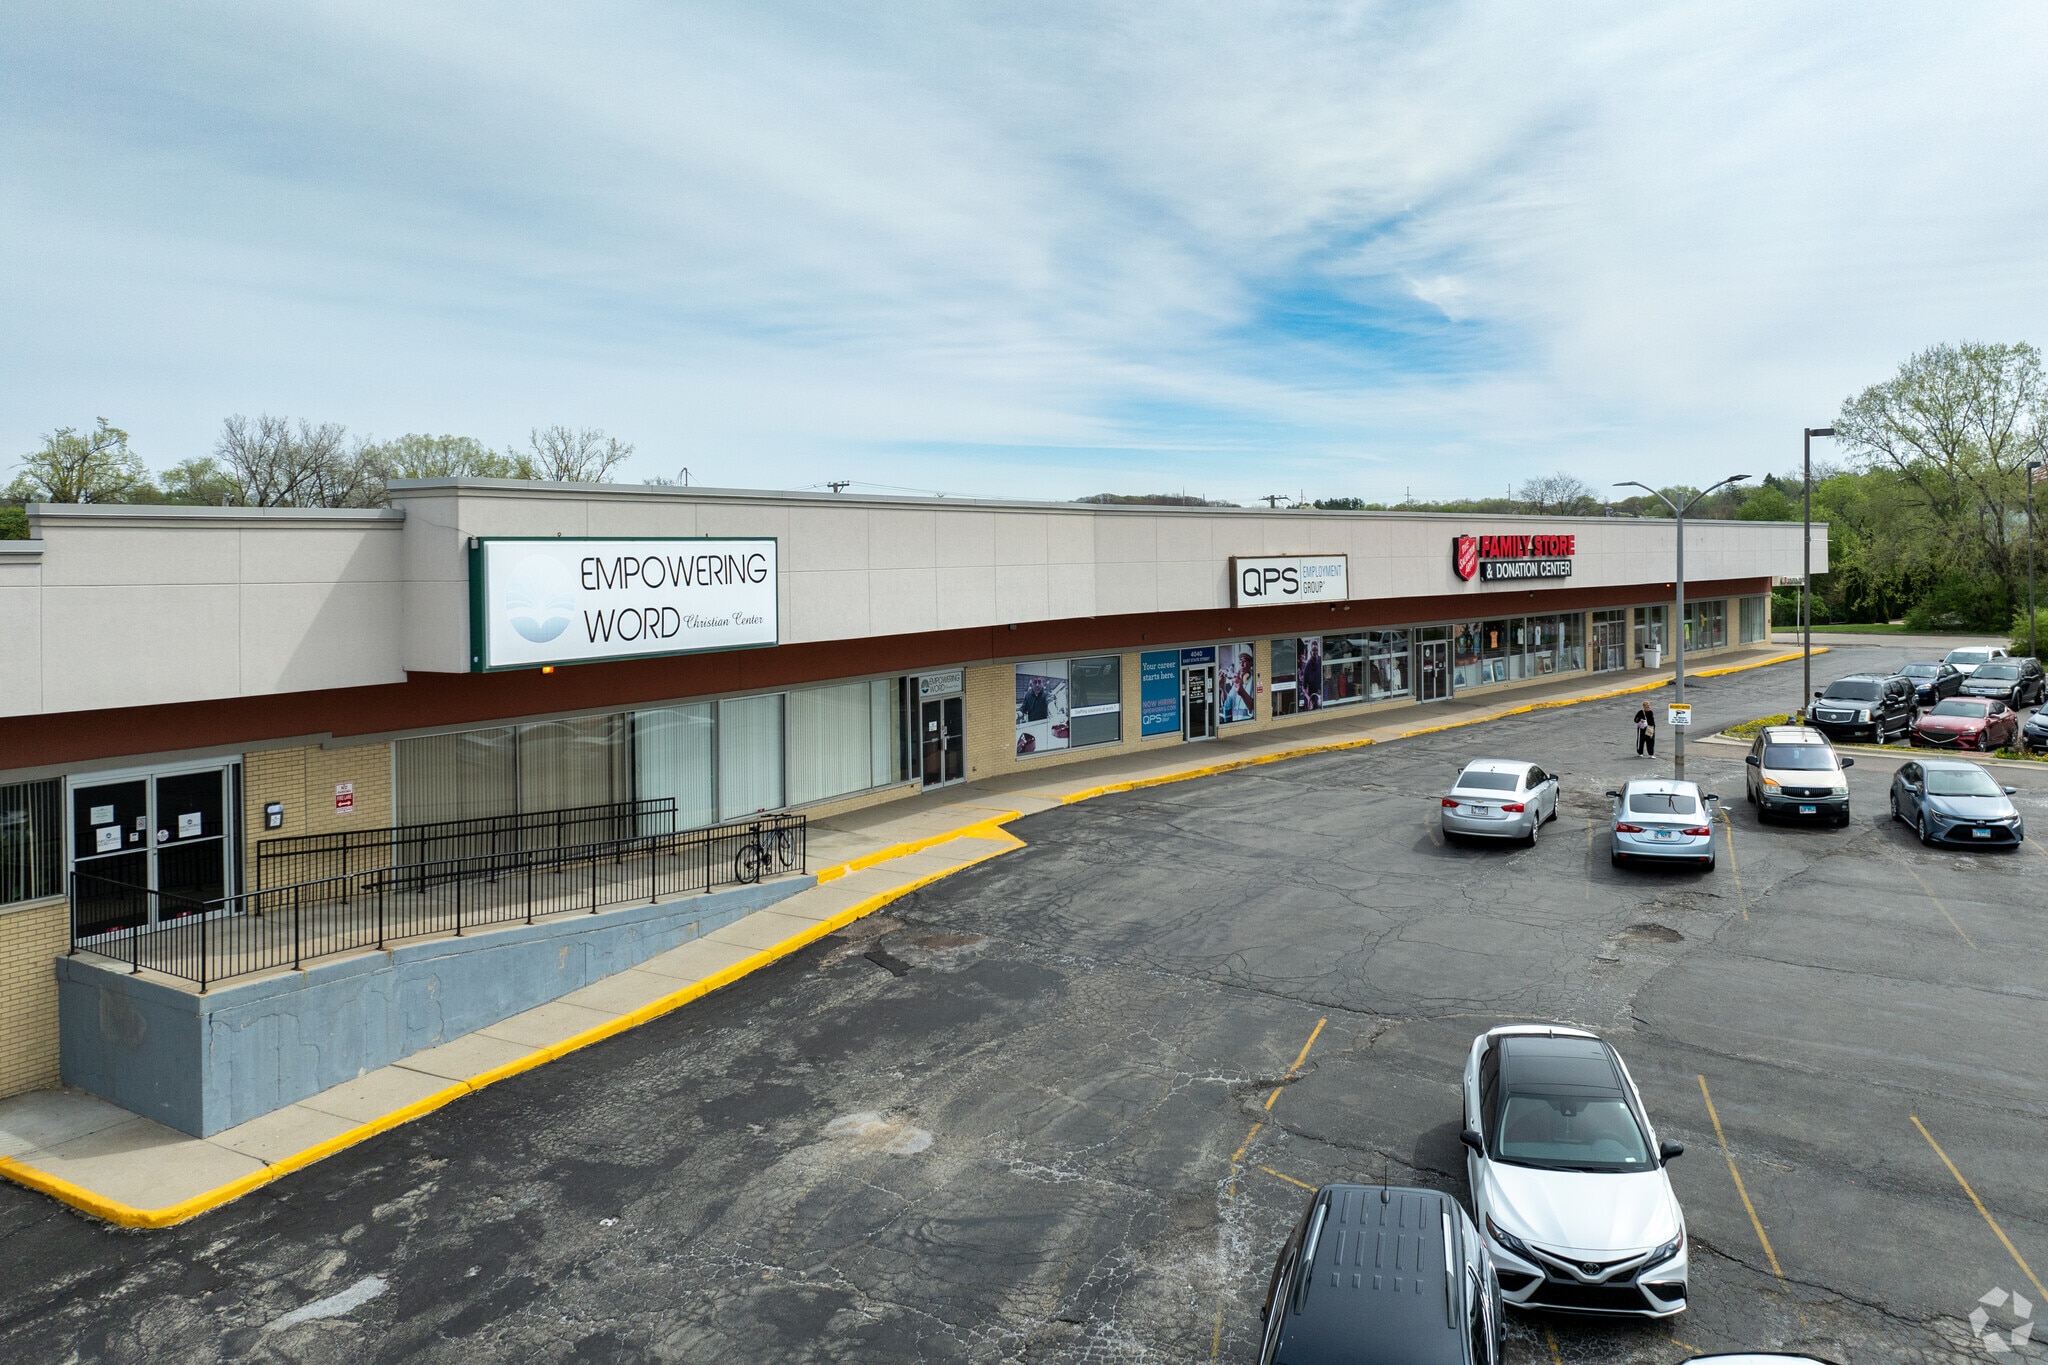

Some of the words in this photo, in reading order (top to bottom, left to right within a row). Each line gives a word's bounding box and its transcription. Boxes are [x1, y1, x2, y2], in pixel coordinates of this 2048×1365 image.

[1481, 535, 1531, 558] FAMILY
[1533, 535, 1575, 556] STORE
[580, 553, 767, 590] EMPOWERING
[1303, 564, 1342, 578] EMPLOYMENT
[1486, 563, 1493, 578] &
[1496, 562, 1538, 578] DONATION
[1540, 561, 1571, 576] CENTER
[1242, 567, 1299, 597] QPS
[584, 606, 681, 643] WORD
[683, 613, 730, 629] Christian
[732, 611, 764, 626] Center
[1142, 662, 1156, 670] Your
[1143, 673, 1160, 682] starts
[1160, 671, 1175, 679] here.
[1143, 700, 1157, 708] NOW
[1143, 714, 1162, 725] QPS
